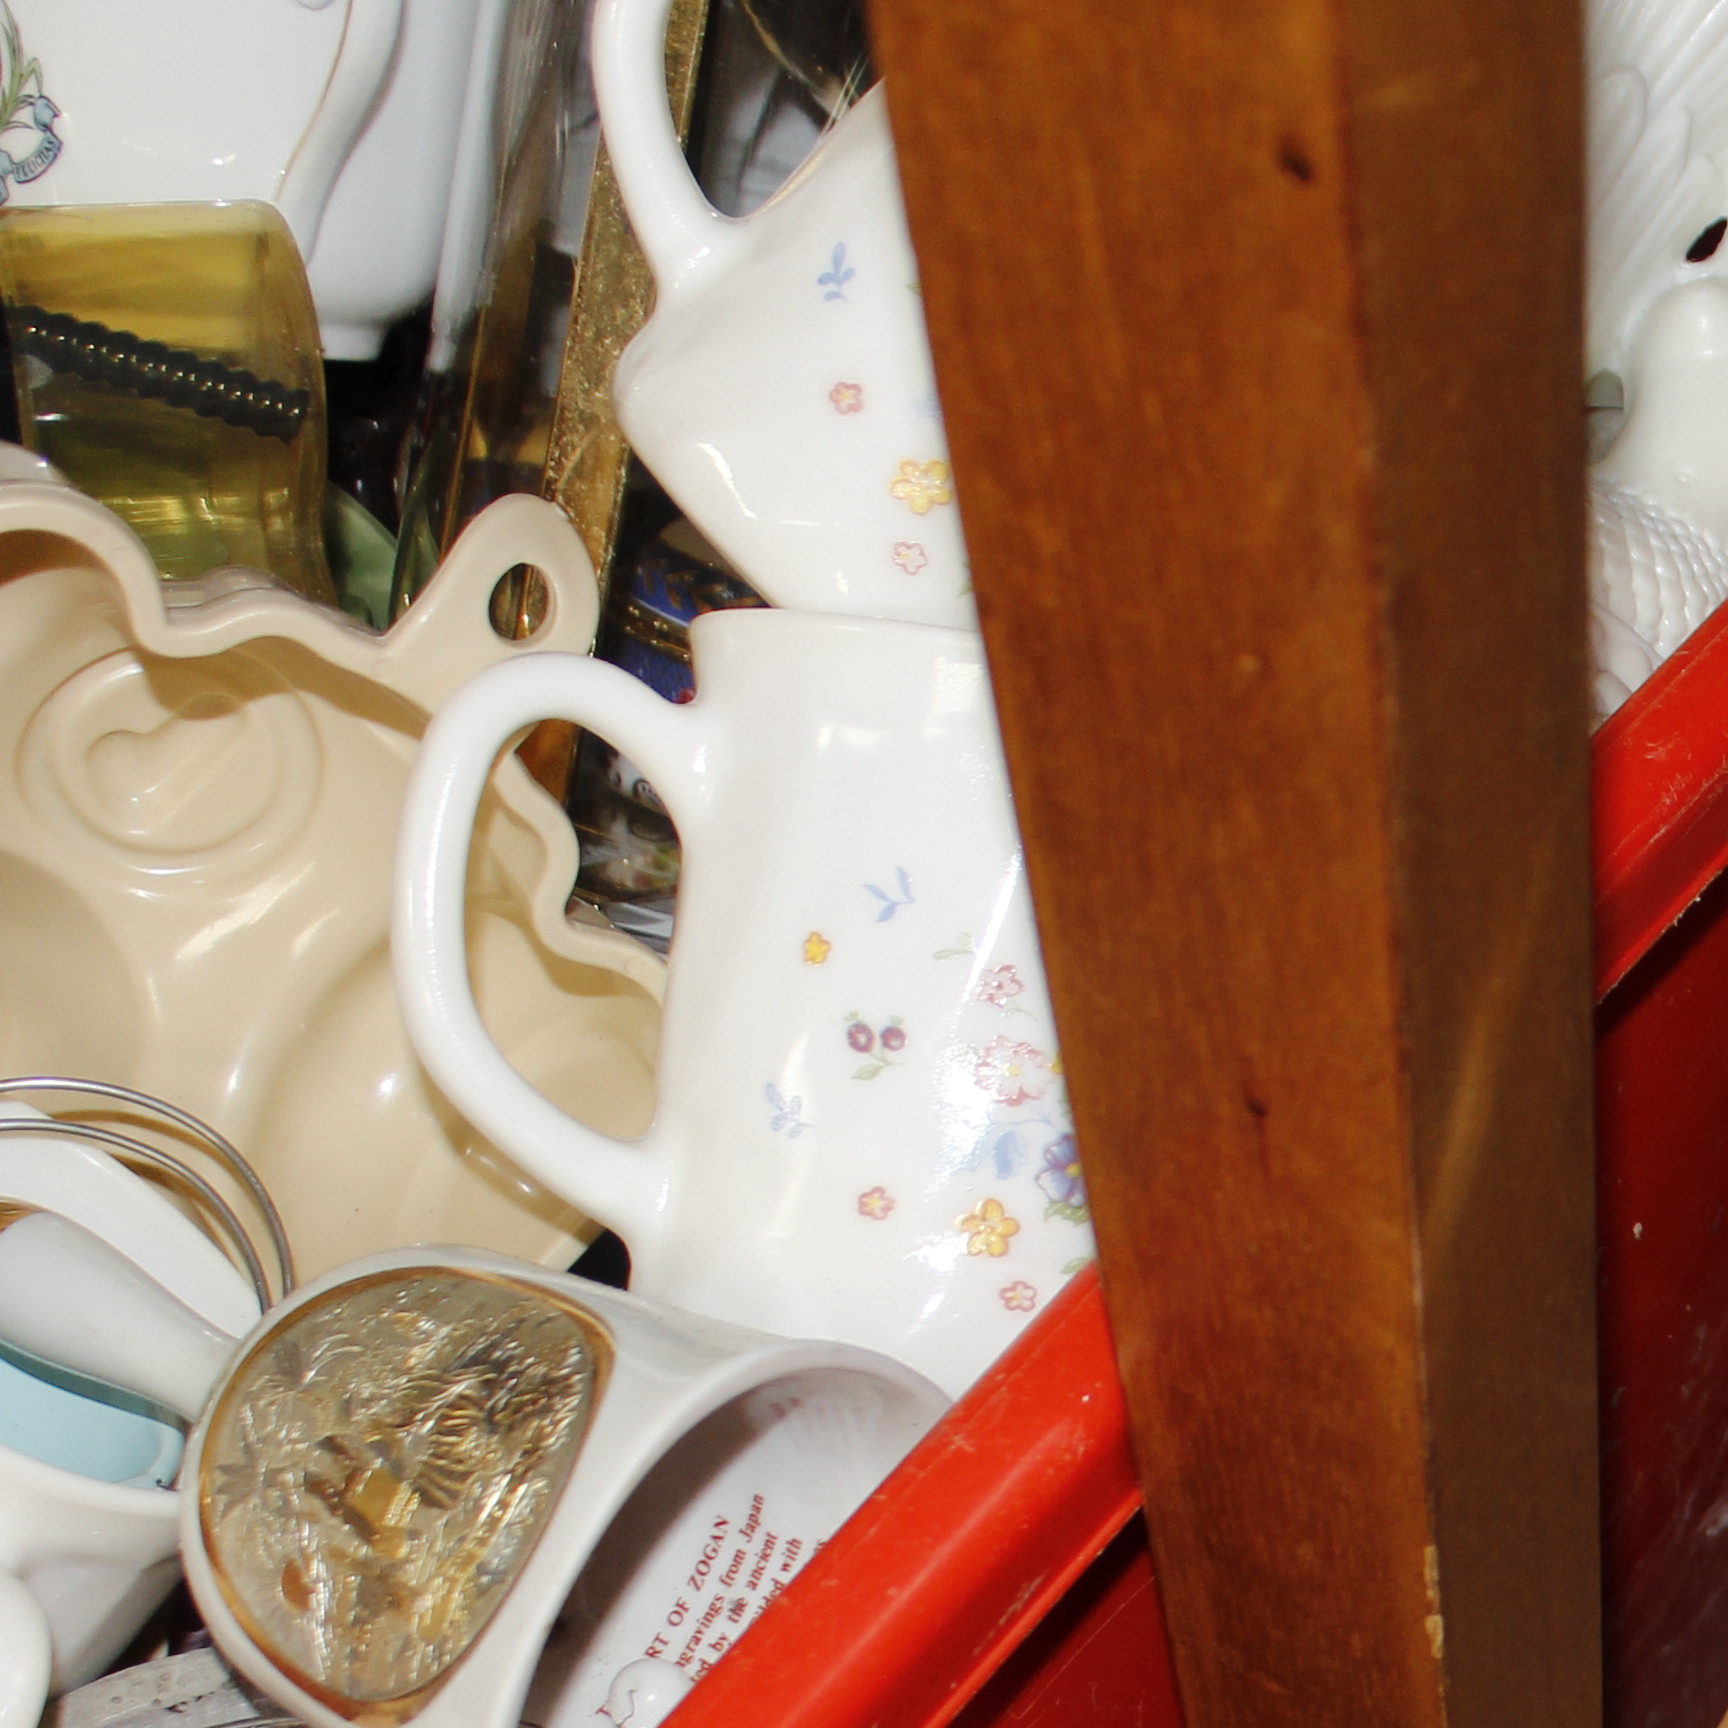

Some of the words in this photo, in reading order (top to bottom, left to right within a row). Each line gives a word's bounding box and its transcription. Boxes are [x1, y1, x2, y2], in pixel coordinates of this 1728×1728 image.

[644, 1632, 669, 1659] RT
[667, 1597, 691, 1627] OF
[688, 1515, 730, 1592] ZOGAN
[709, 1632, 732, 1654] by
[726, 1596, 748, 1624] the
[745, 1531, 778, 1591] ancient
[719, 1548, 747, 1588] from
[738, 1493, 765, 1543] Japan
[780, 1538, 803, 1573] with
